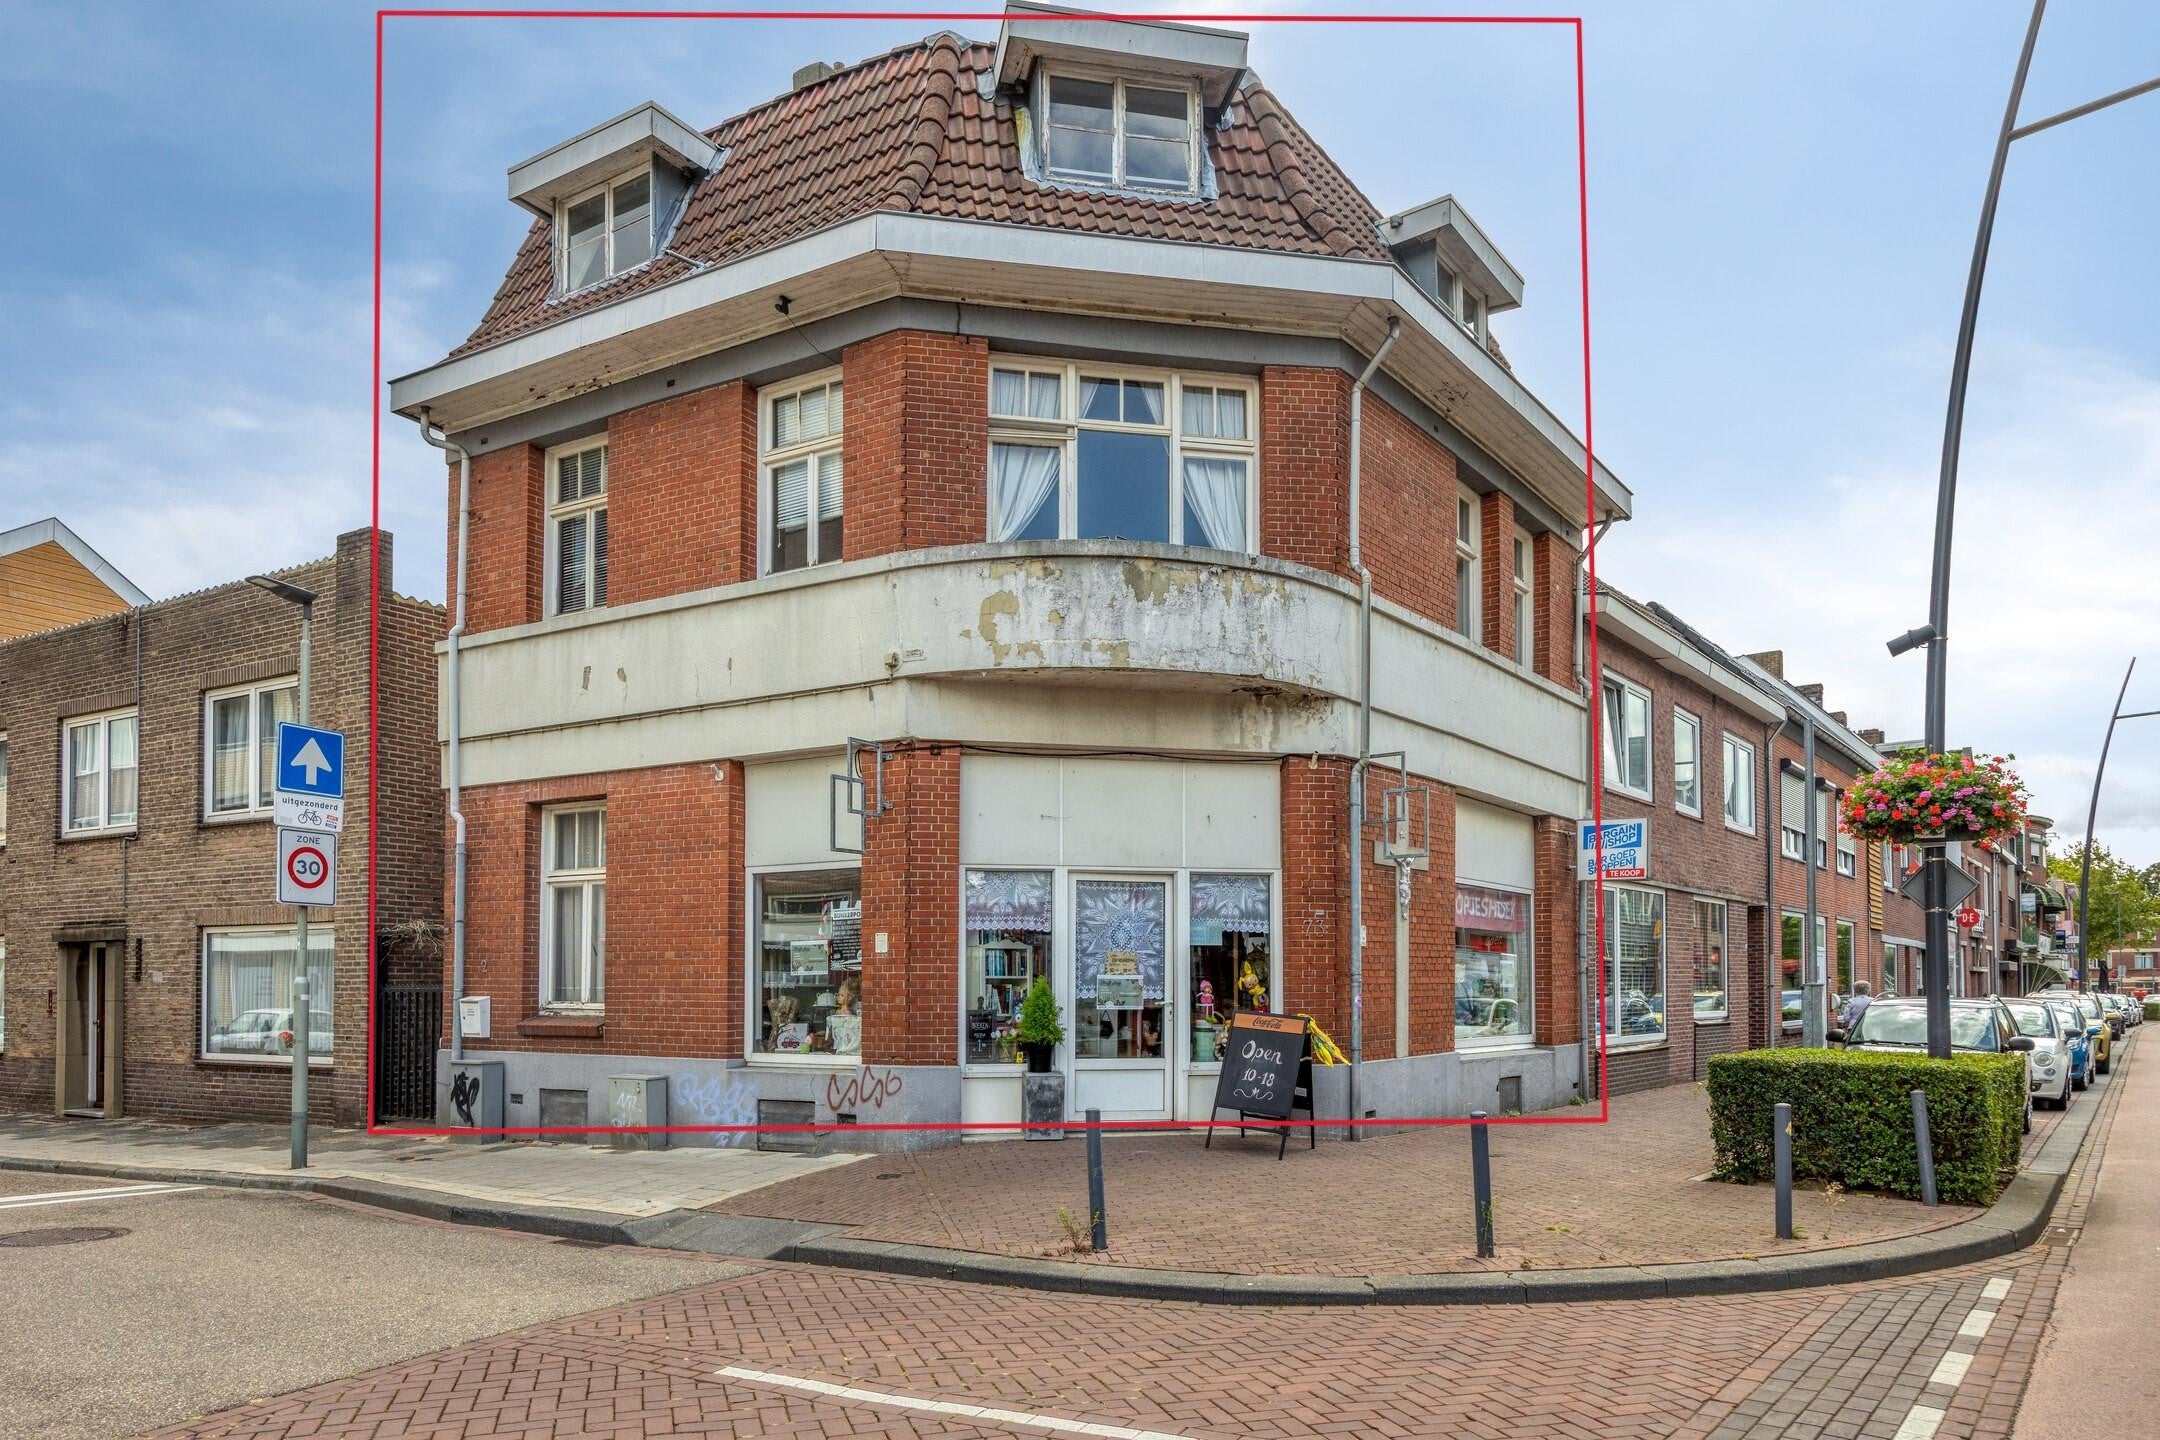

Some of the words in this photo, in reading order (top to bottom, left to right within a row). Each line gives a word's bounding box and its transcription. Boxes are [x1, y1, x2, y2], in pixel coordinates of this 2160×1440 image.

[282, 797, 338, 811] uitgezonderd
[296, 835, 321, 845] ZONE
[1608, 832, 1636, 847] SHOP
[1588, 856, 1607, 868] BR
[1609, 849, 1636, 862] GOED
[296, 860, 321, 876] 30
[1619, 869, 1641, 877] KOOP
[1241, 1040, 1283, 1065] Open
[1241, 1067, 1275, 1087] 10-18
